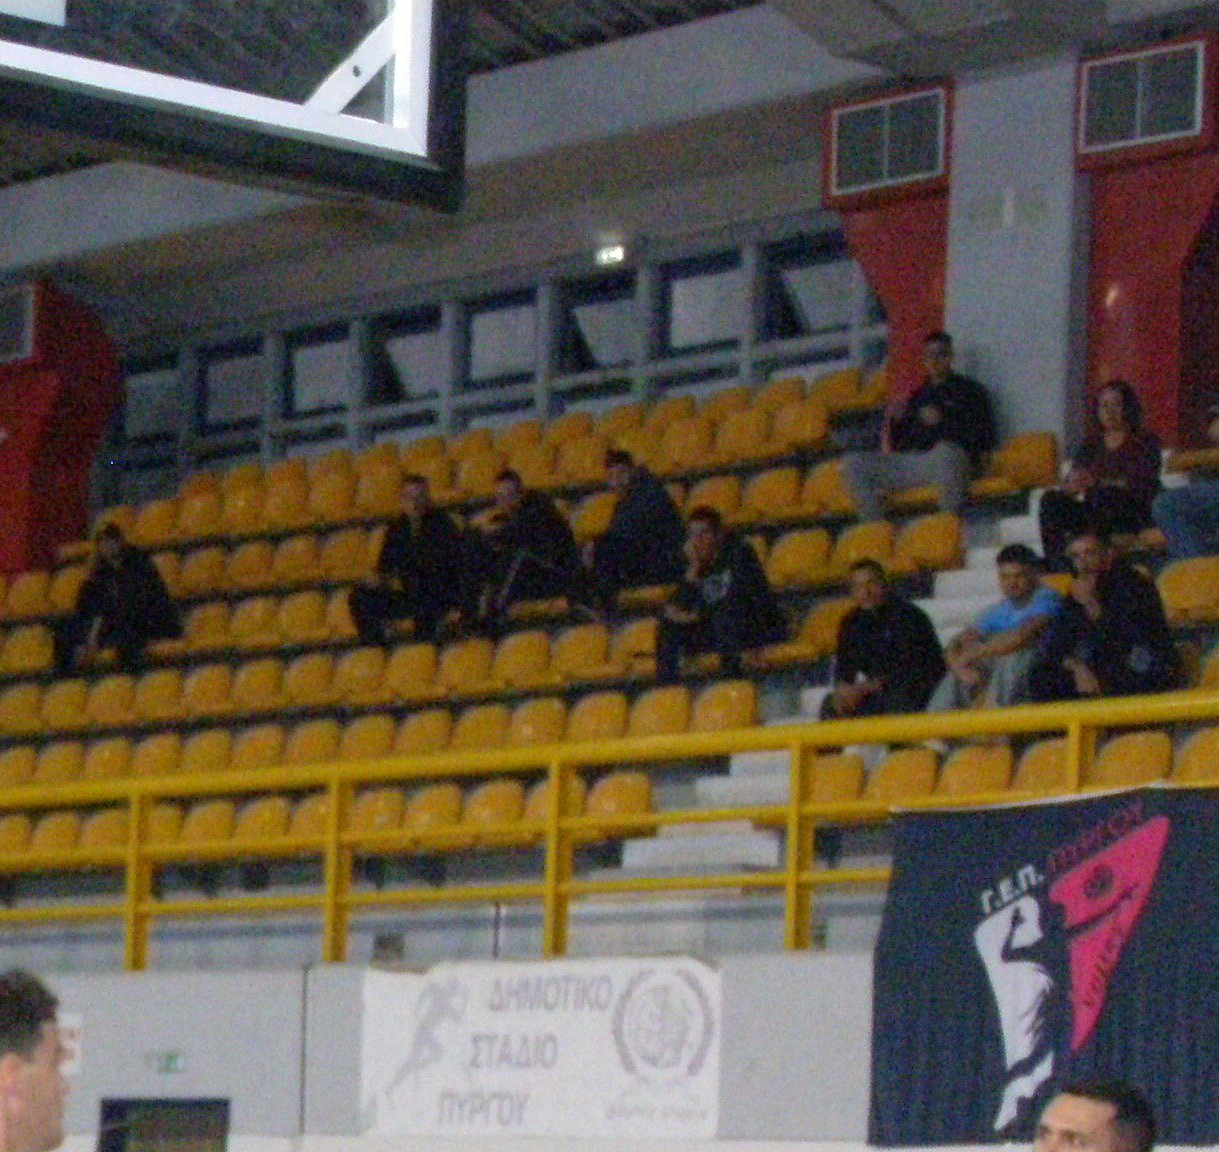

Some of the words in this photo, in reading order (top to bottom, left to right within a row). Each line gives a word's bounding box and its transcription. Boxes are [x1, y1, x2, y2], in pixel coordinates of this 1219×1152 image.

[488, 974, 613, 1013] ΔΗΜΟΤΙΚΟ
[469, 1032, 559, 1070] ΣΤΑΔΙΟ
[436, 1090, 531, 1127] ΠΥΡΓΟΥ
